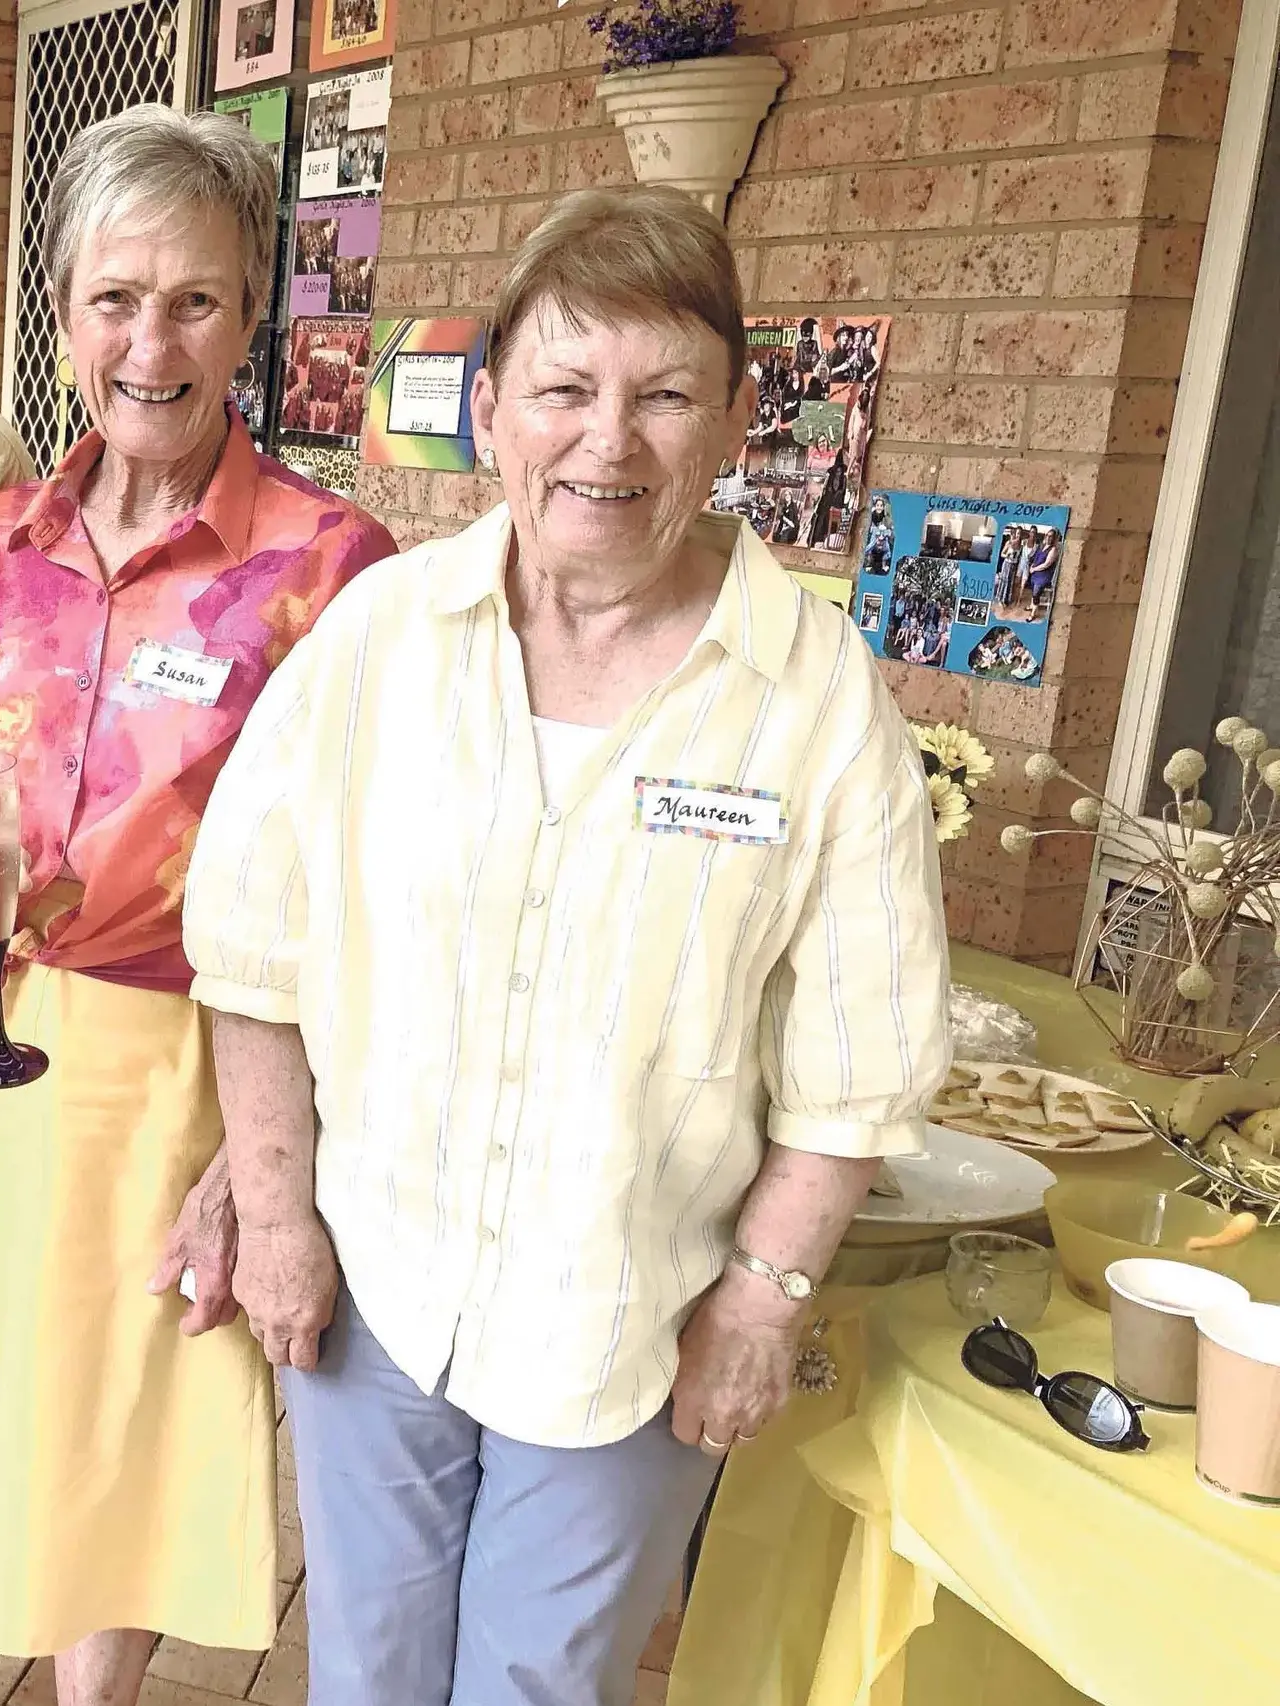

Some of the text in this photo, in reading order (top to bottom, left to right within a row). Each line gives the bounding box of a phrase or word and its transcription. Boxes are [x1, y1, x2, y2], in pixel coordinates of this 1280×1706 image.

[961, 498, 991, 515] Night
[151, 660, 208, 687] Susan
[652, 795, 758, 826] Maureen
